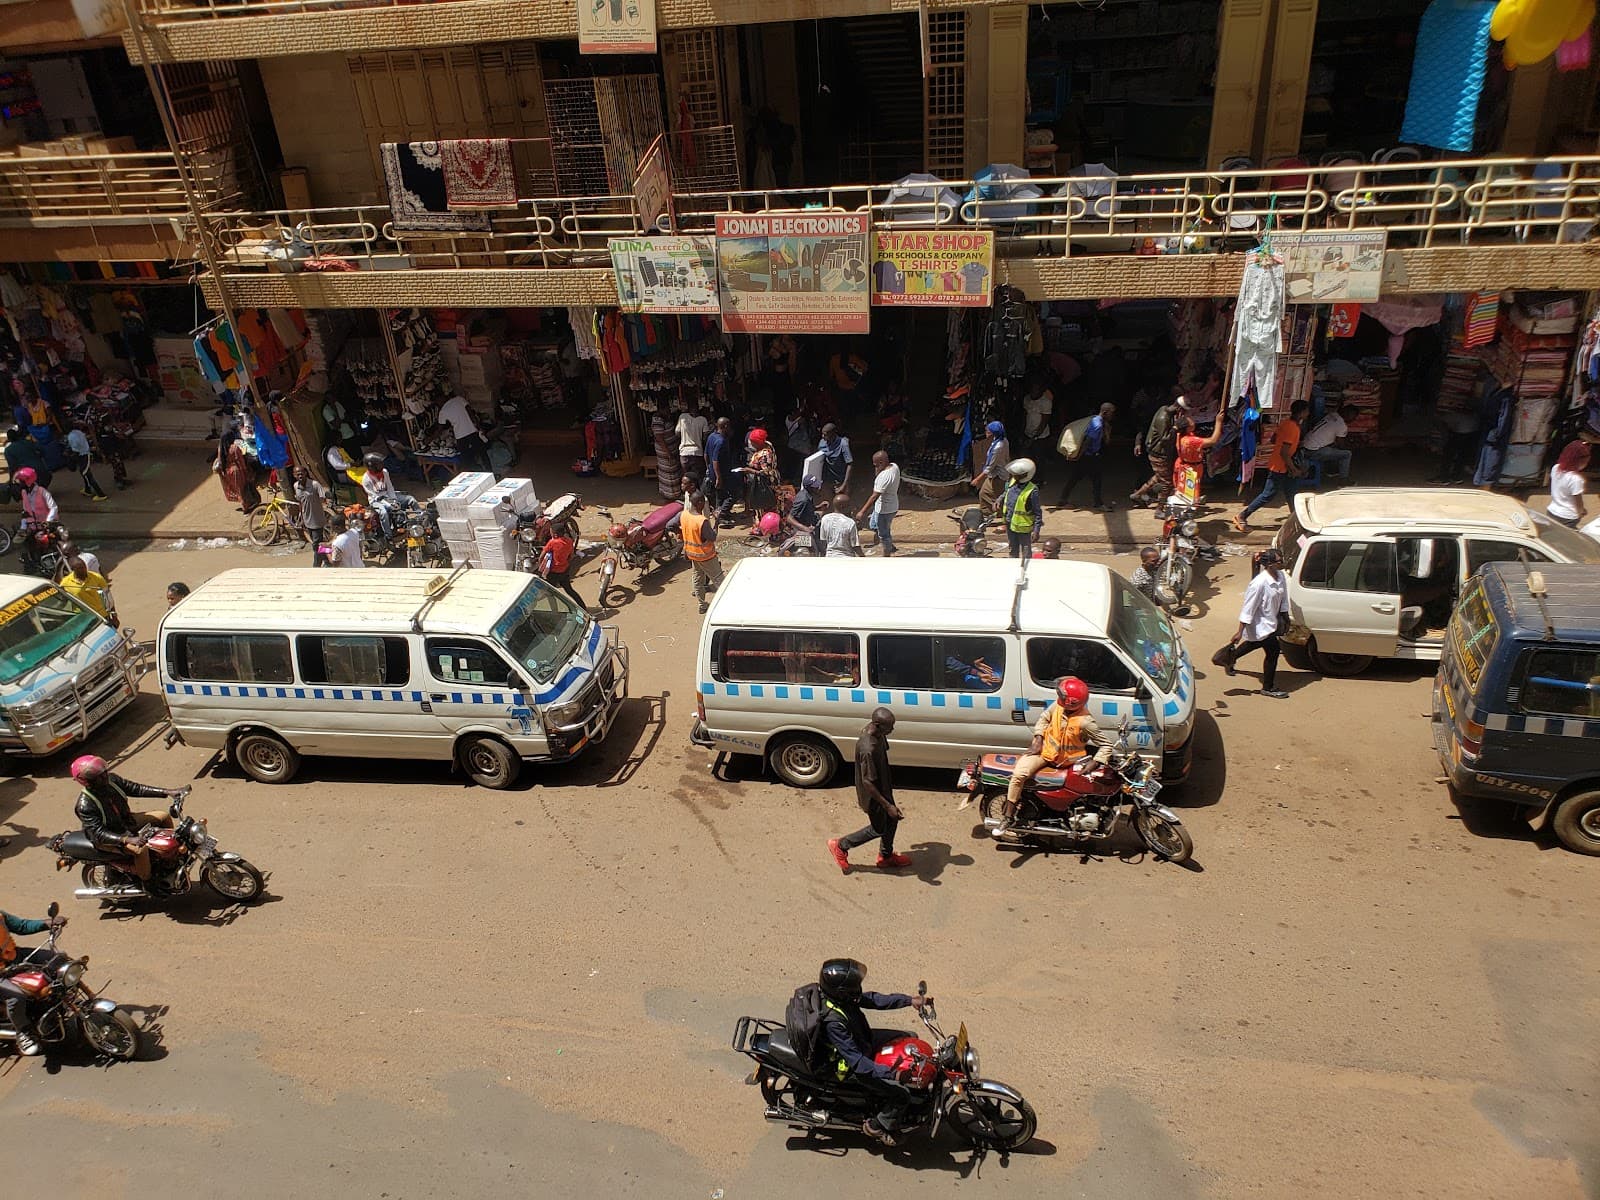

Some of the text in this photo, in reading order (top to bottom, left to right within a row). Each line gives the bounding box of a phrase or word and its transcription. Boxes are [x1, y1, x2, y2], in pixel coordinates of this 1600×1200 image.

[722, 217, 861, 235] JONAH ELECTRONICS
[610, 241, 654, 252] JUMA
[877, 233, 988, 251] STAR SHOP
